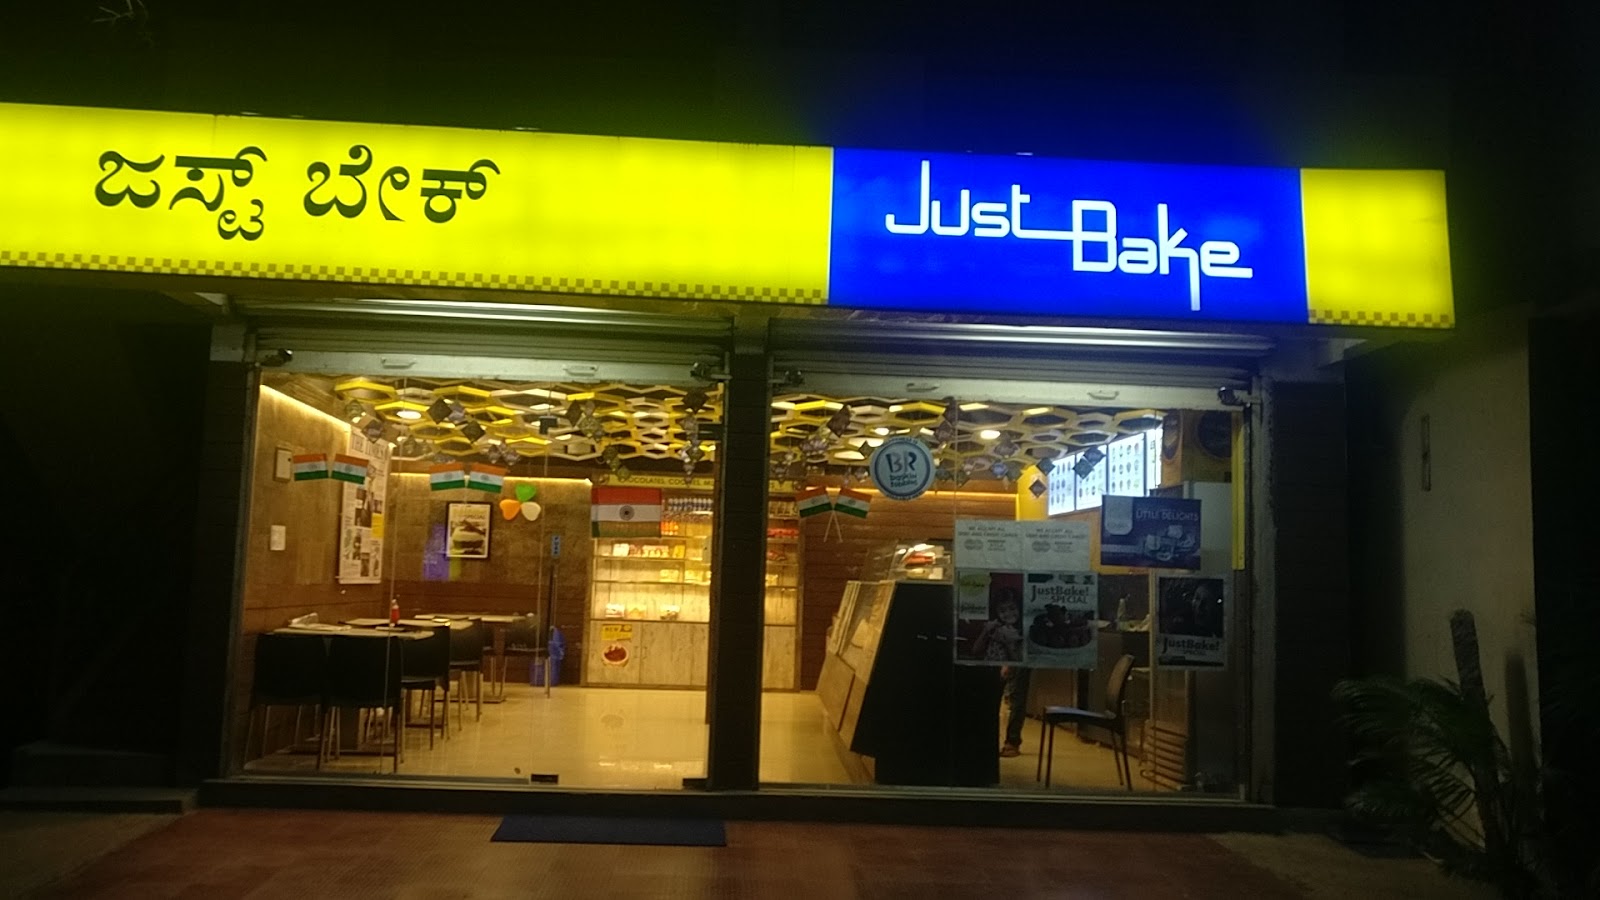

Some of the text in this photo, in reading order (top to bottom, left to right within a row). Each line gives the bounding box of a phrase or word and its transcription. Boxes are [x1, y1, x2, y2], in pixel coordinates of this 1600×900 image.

[94, 144, 501, 242] ಜಸ್ಟ್ ಬೇಕ್
[885, 159, 1254, 312] Just Bake
[1050, 595, 1088, 604] SPECIAL
